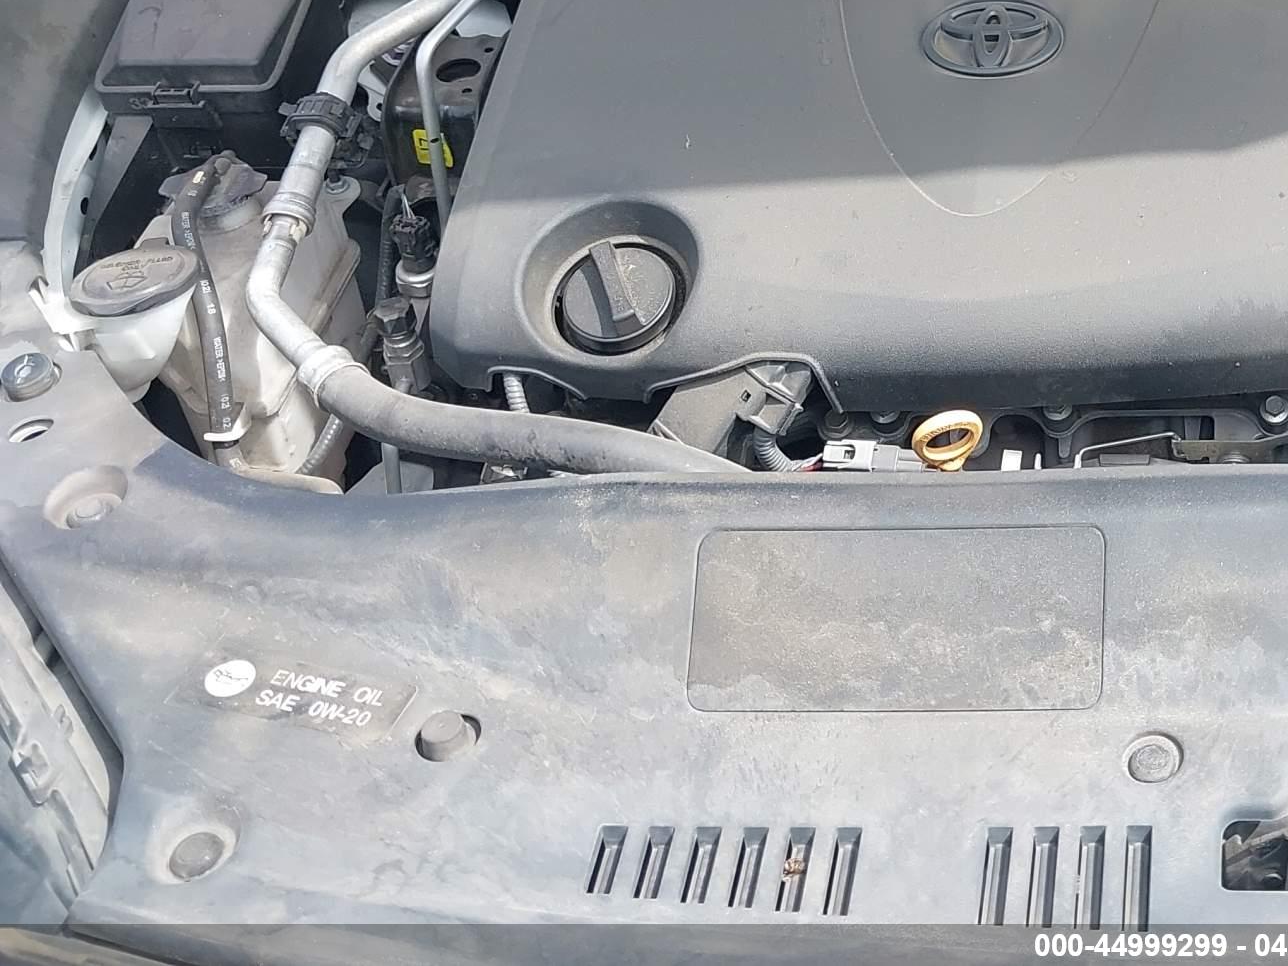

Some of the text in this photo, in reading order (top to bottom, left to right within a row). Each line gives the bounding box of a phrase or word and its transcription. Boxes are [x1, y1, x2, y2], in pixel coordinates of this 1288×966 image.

[270, 669, 383, 707] ENGINE OIL
[255, 689, 372, 727] SAE 0W-20
